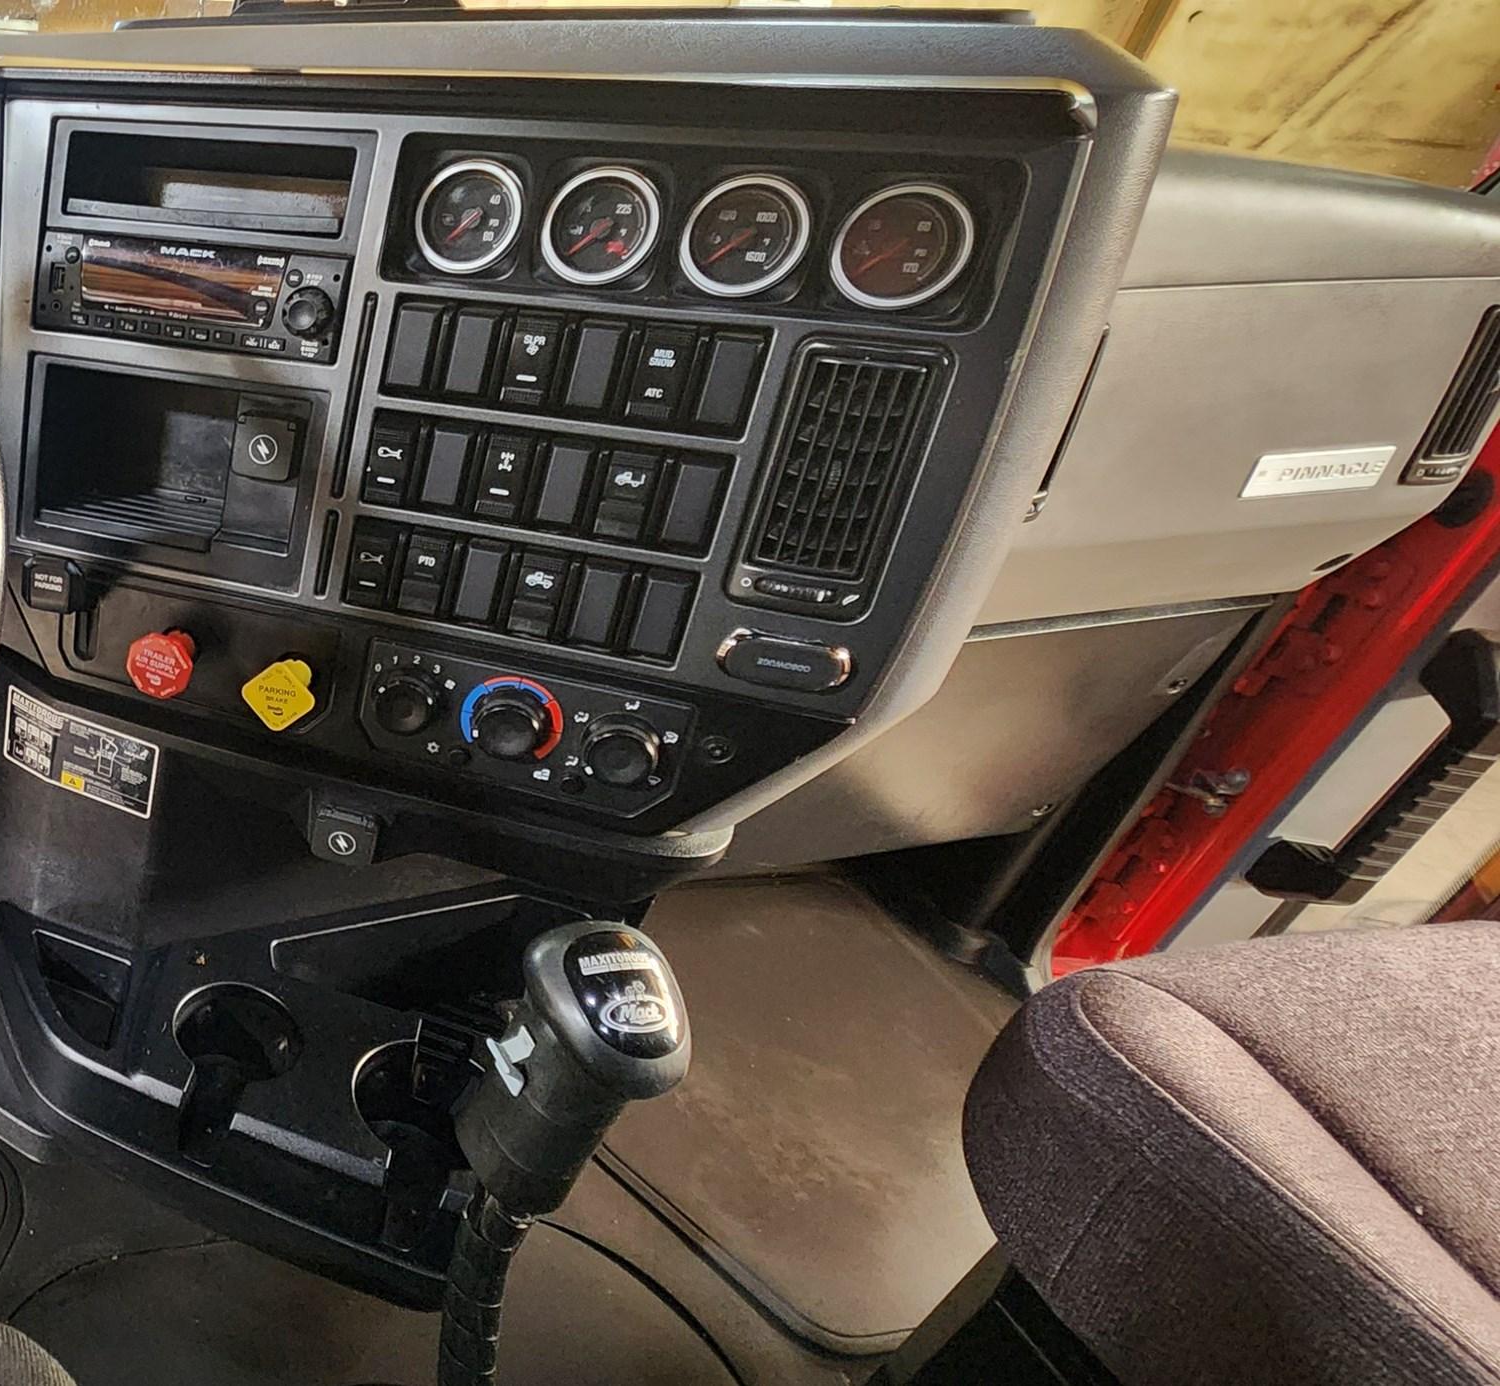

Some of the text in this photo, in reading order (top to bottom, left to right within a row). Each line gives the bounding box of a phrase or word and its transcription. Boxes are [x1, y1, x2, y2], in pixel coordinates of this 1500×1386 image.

[615, 203, 633, 215] 225
[160, 246, 217, 259] MACK
[523, 334, 547, 346] SLPR
[653, 348, 675, 359] MUD
[649, 357, 677, 368] SNOW
[644, 387, 664, 399] ATC
[1278, 460, 1386, 482] PINNACLE
[417, 555, 436, 567] PTO
[34, 573, 63, 584] NOT FOR
[34, 581, 62, 593] PARKING
[143, 649, 176, 666] TRAILER
[393, 655, 399, 665] 1
[413, 655, 421, 665] 2
[135, 654, 149, 665] AIR
[149, 659, 181, 676] SUPPLY
[374, 663, 382, 673] 0
[433, 664, 441, 674] 3
[258, 685, 297, 698] PARKING
[265, 695, 289, 705] BRAKE
[618, 1003, 663, 1025] Mack
